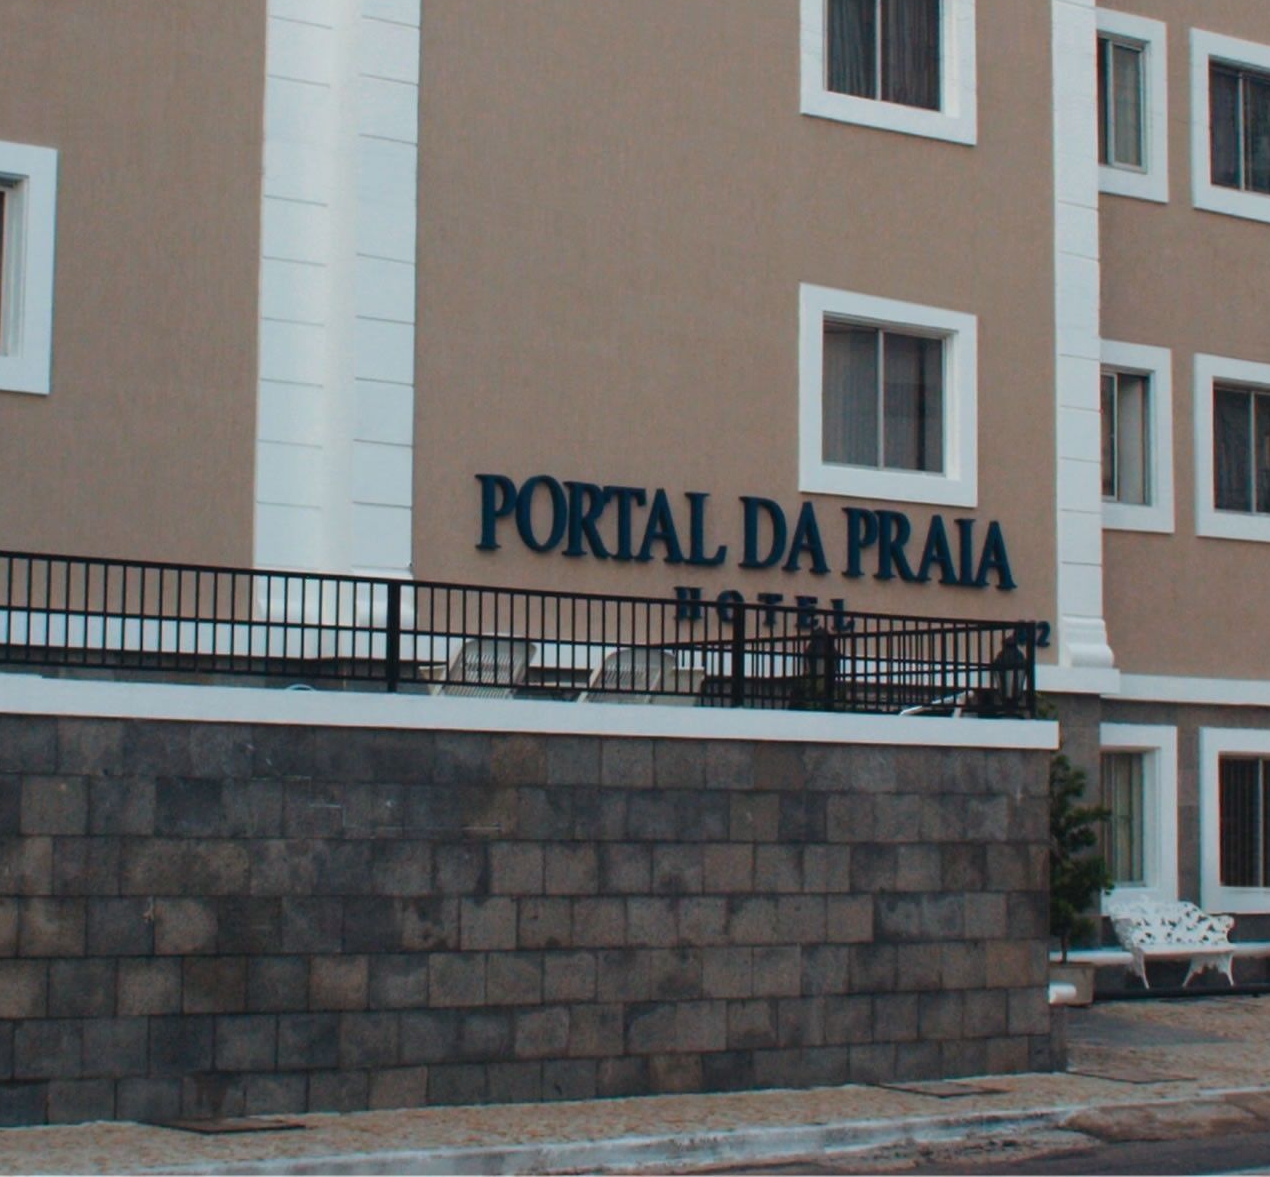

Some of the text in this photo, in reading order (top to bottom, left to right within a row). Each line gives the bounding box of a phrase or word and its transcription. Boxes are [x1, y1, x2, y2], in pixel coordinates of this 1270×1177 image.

[475, 474, 1017, 590] PORTAL DA PRAIA
[674, 586, 856, 632] HOTEL
